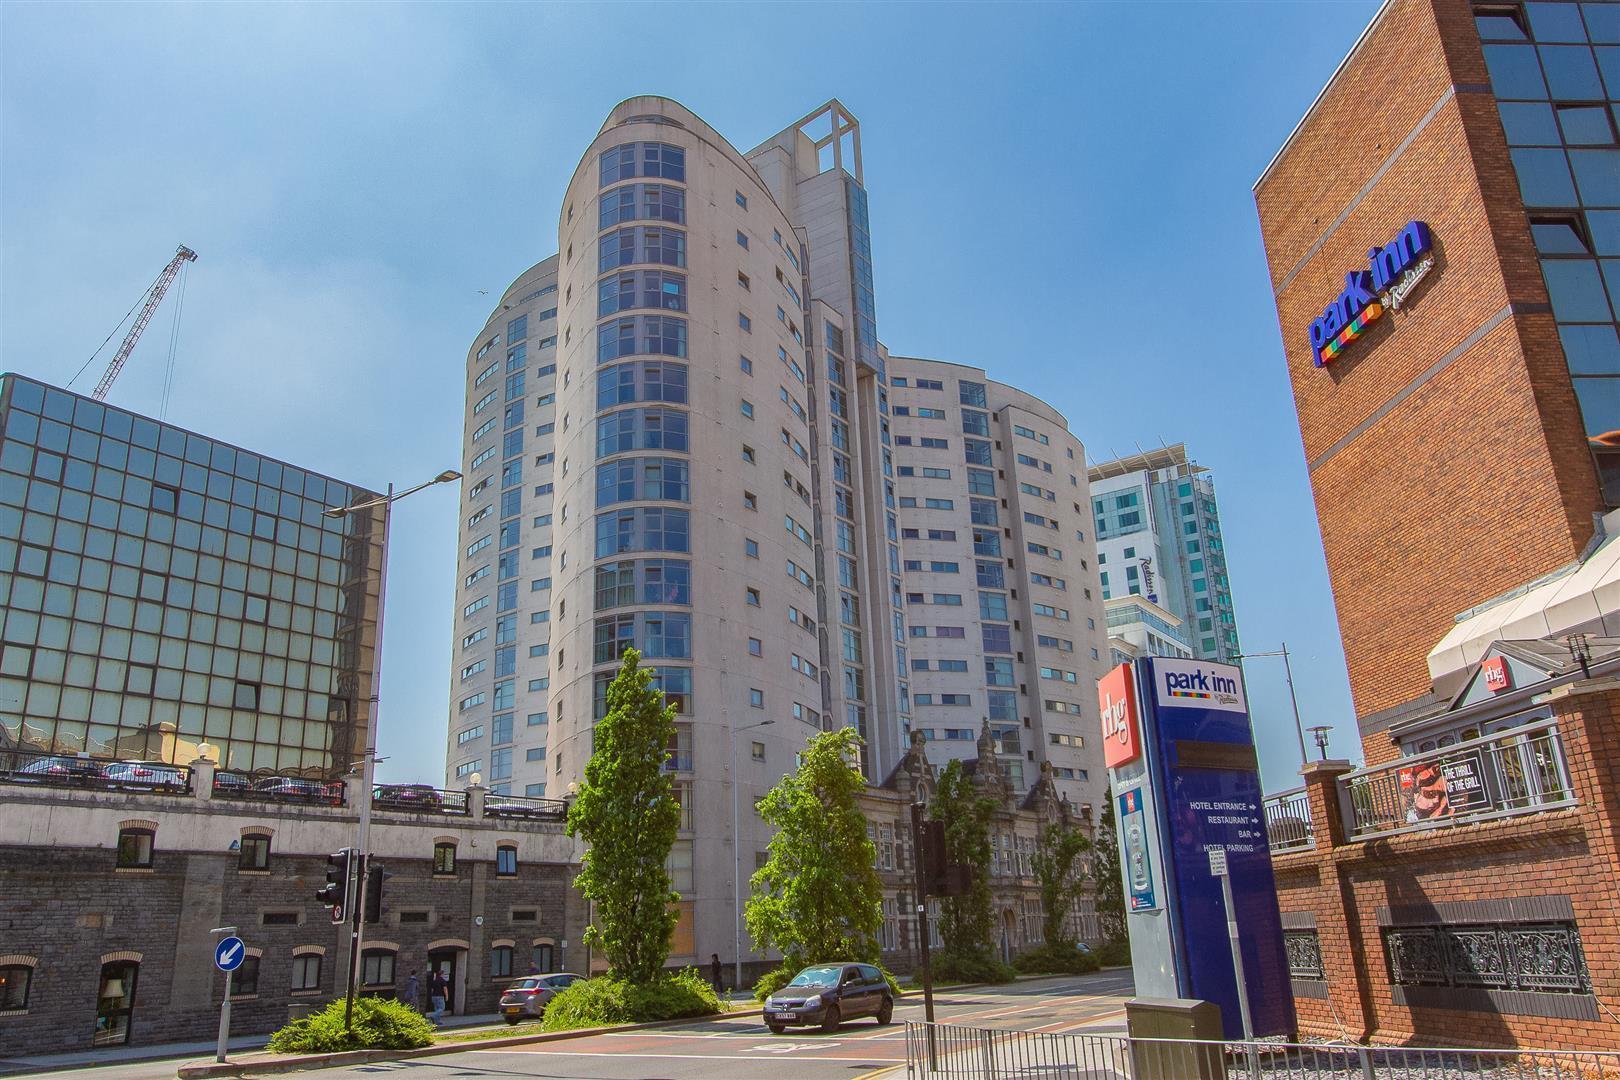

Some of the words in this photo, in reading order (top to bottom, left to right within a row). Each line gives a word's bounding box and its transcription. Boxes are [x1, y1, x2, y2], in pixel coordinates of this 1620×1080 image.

[1308, 269, 1377, 368] park
[1367, 220, 1432, 292] inn
[1165, 668, 1210, 696] park
[1211, 671, 1237, 694] inn
[1485, 666, 1504, 684] rbg
[1101, 693, 1129, 744] rbg
[1444, 766, 1456, 779] THE
[1455, 763, 1474, 778] THRILL
[1446, 780, 1455, 793] OF
[1455, 779, 1465, 791] THE
[1464, 776, 1480, 789] GRILL
[1190, 801, 1213, 810] HOTEL
[1214, 802, 1247, 811] ENTRANCE
[1207, 815, 1249, 824] RESTAURANT
[1238, 830, 1252, 838] BAR
[1203, 844, 1226, 852] HOTEL
[1226, 844, 1254, 852] PARKING
